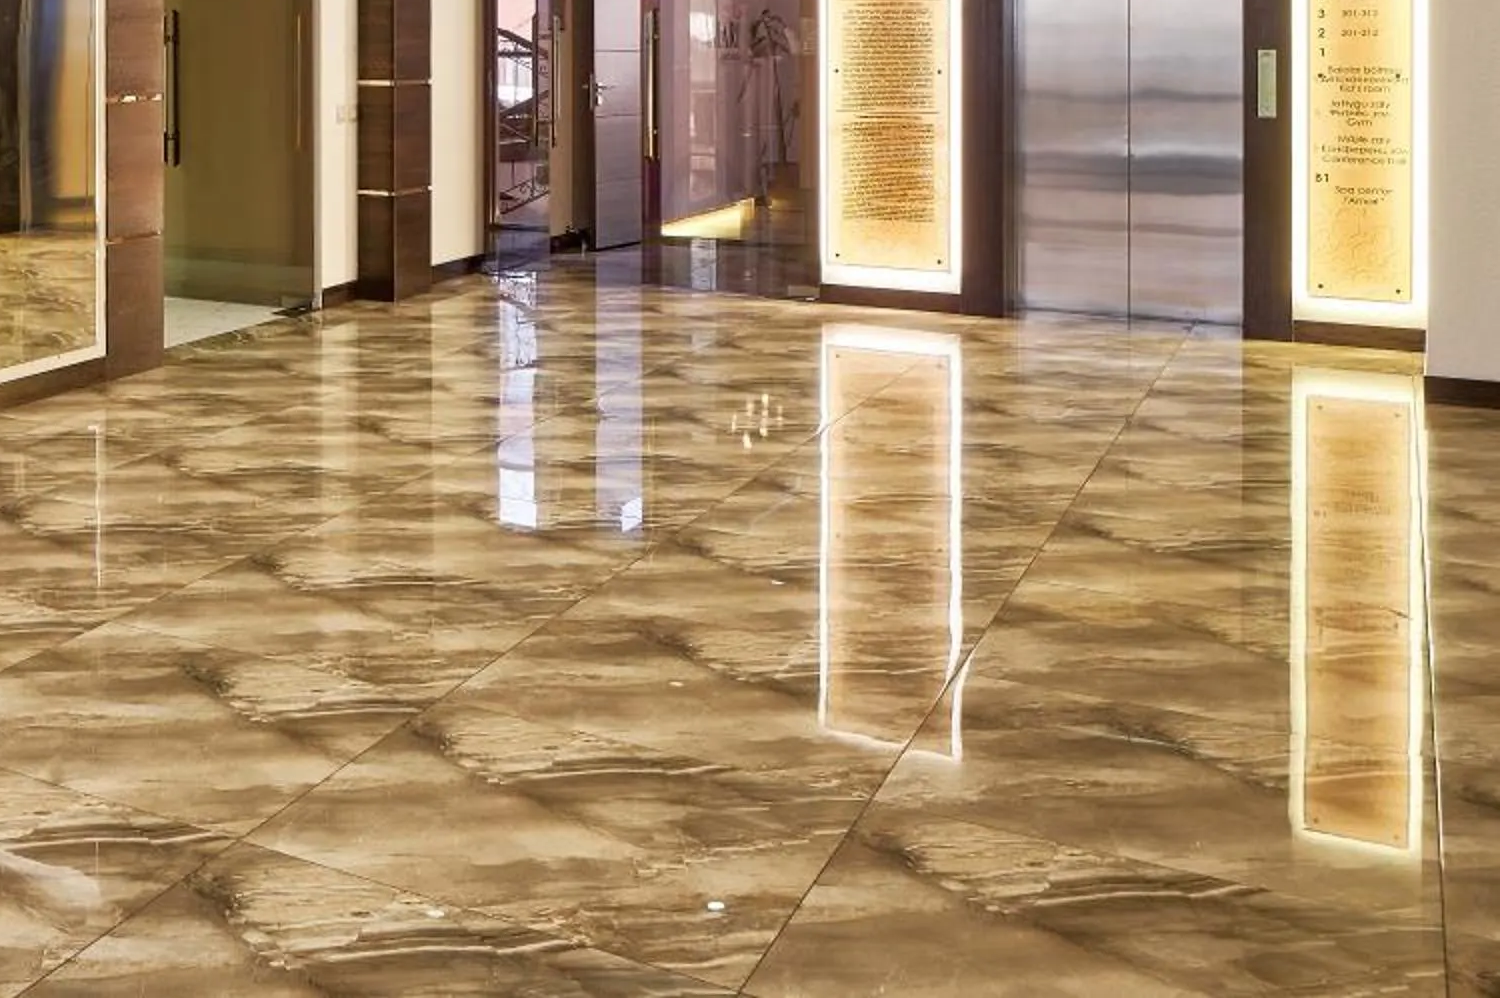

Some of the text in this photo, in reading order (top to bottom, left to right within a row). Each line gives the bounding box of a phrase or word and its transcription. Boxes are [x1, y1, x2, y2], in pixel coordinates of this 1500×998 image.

[1318, 8, 1325, 19] 3
[1318, 27, 1325, 39] 2
[1319, 47, 1325, 57] 1
[1346, 117, 1373, 127] Gym
